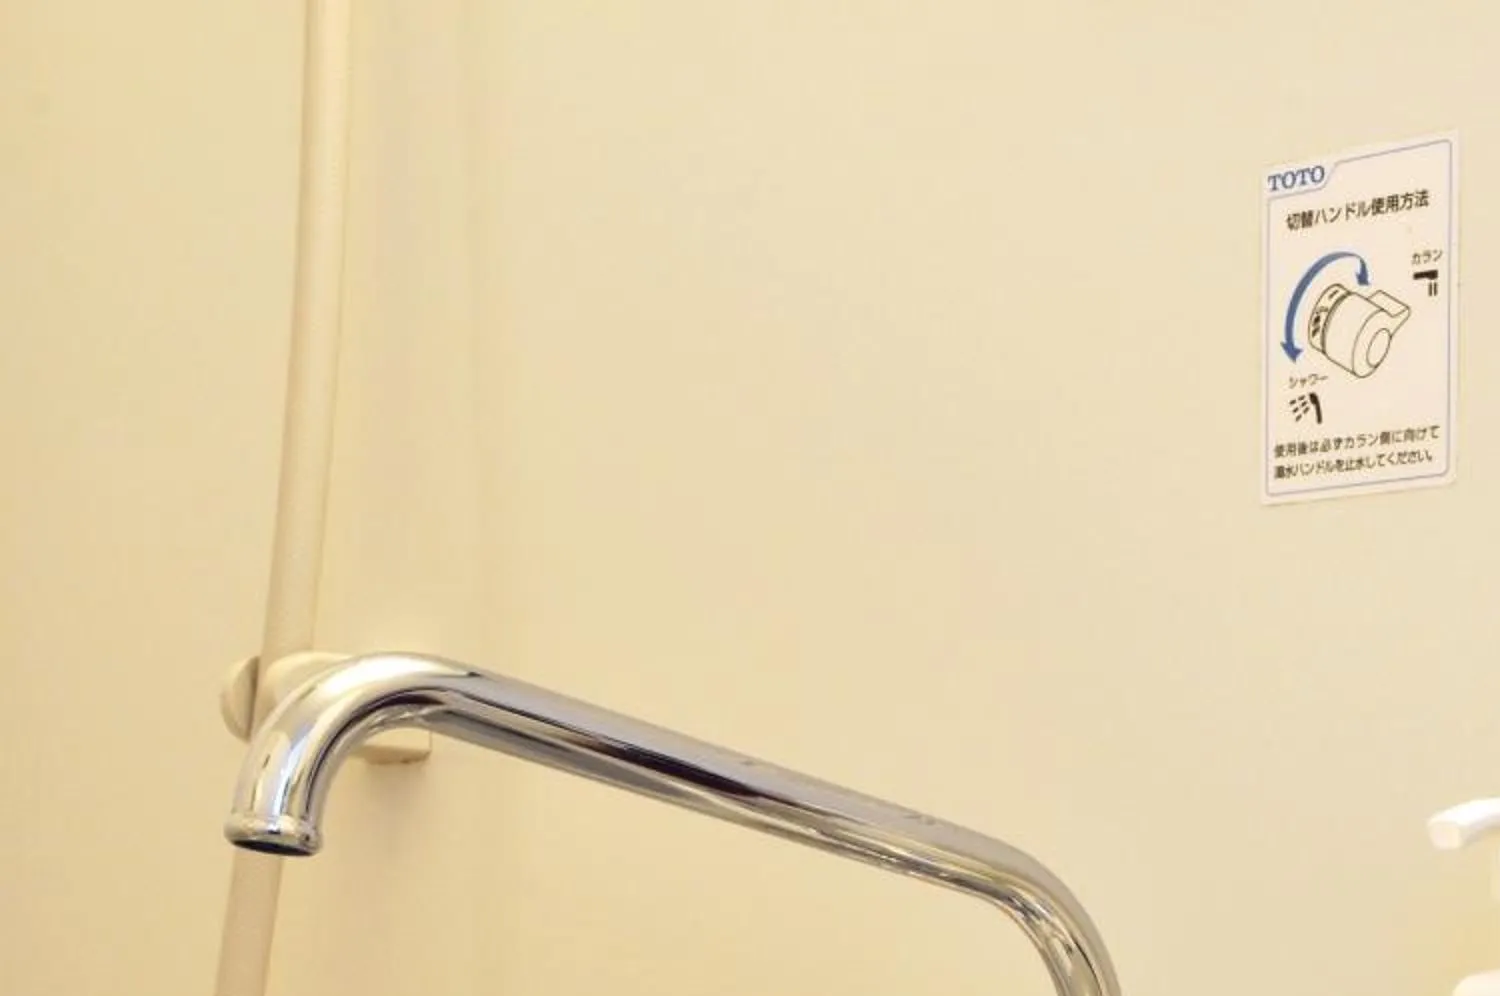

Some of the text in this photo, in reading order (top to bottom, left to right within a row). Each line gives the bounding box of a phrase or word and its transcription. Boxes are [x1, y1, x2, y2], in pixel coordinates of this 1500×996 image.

[1268, 166, 1325, 191] TOTO
[1286, 189, 1429, 231] 切替ハンドル使用方法
[1411, 249, 1443, 265] カラン
[1288, 374, 1328, 388] シャワー
